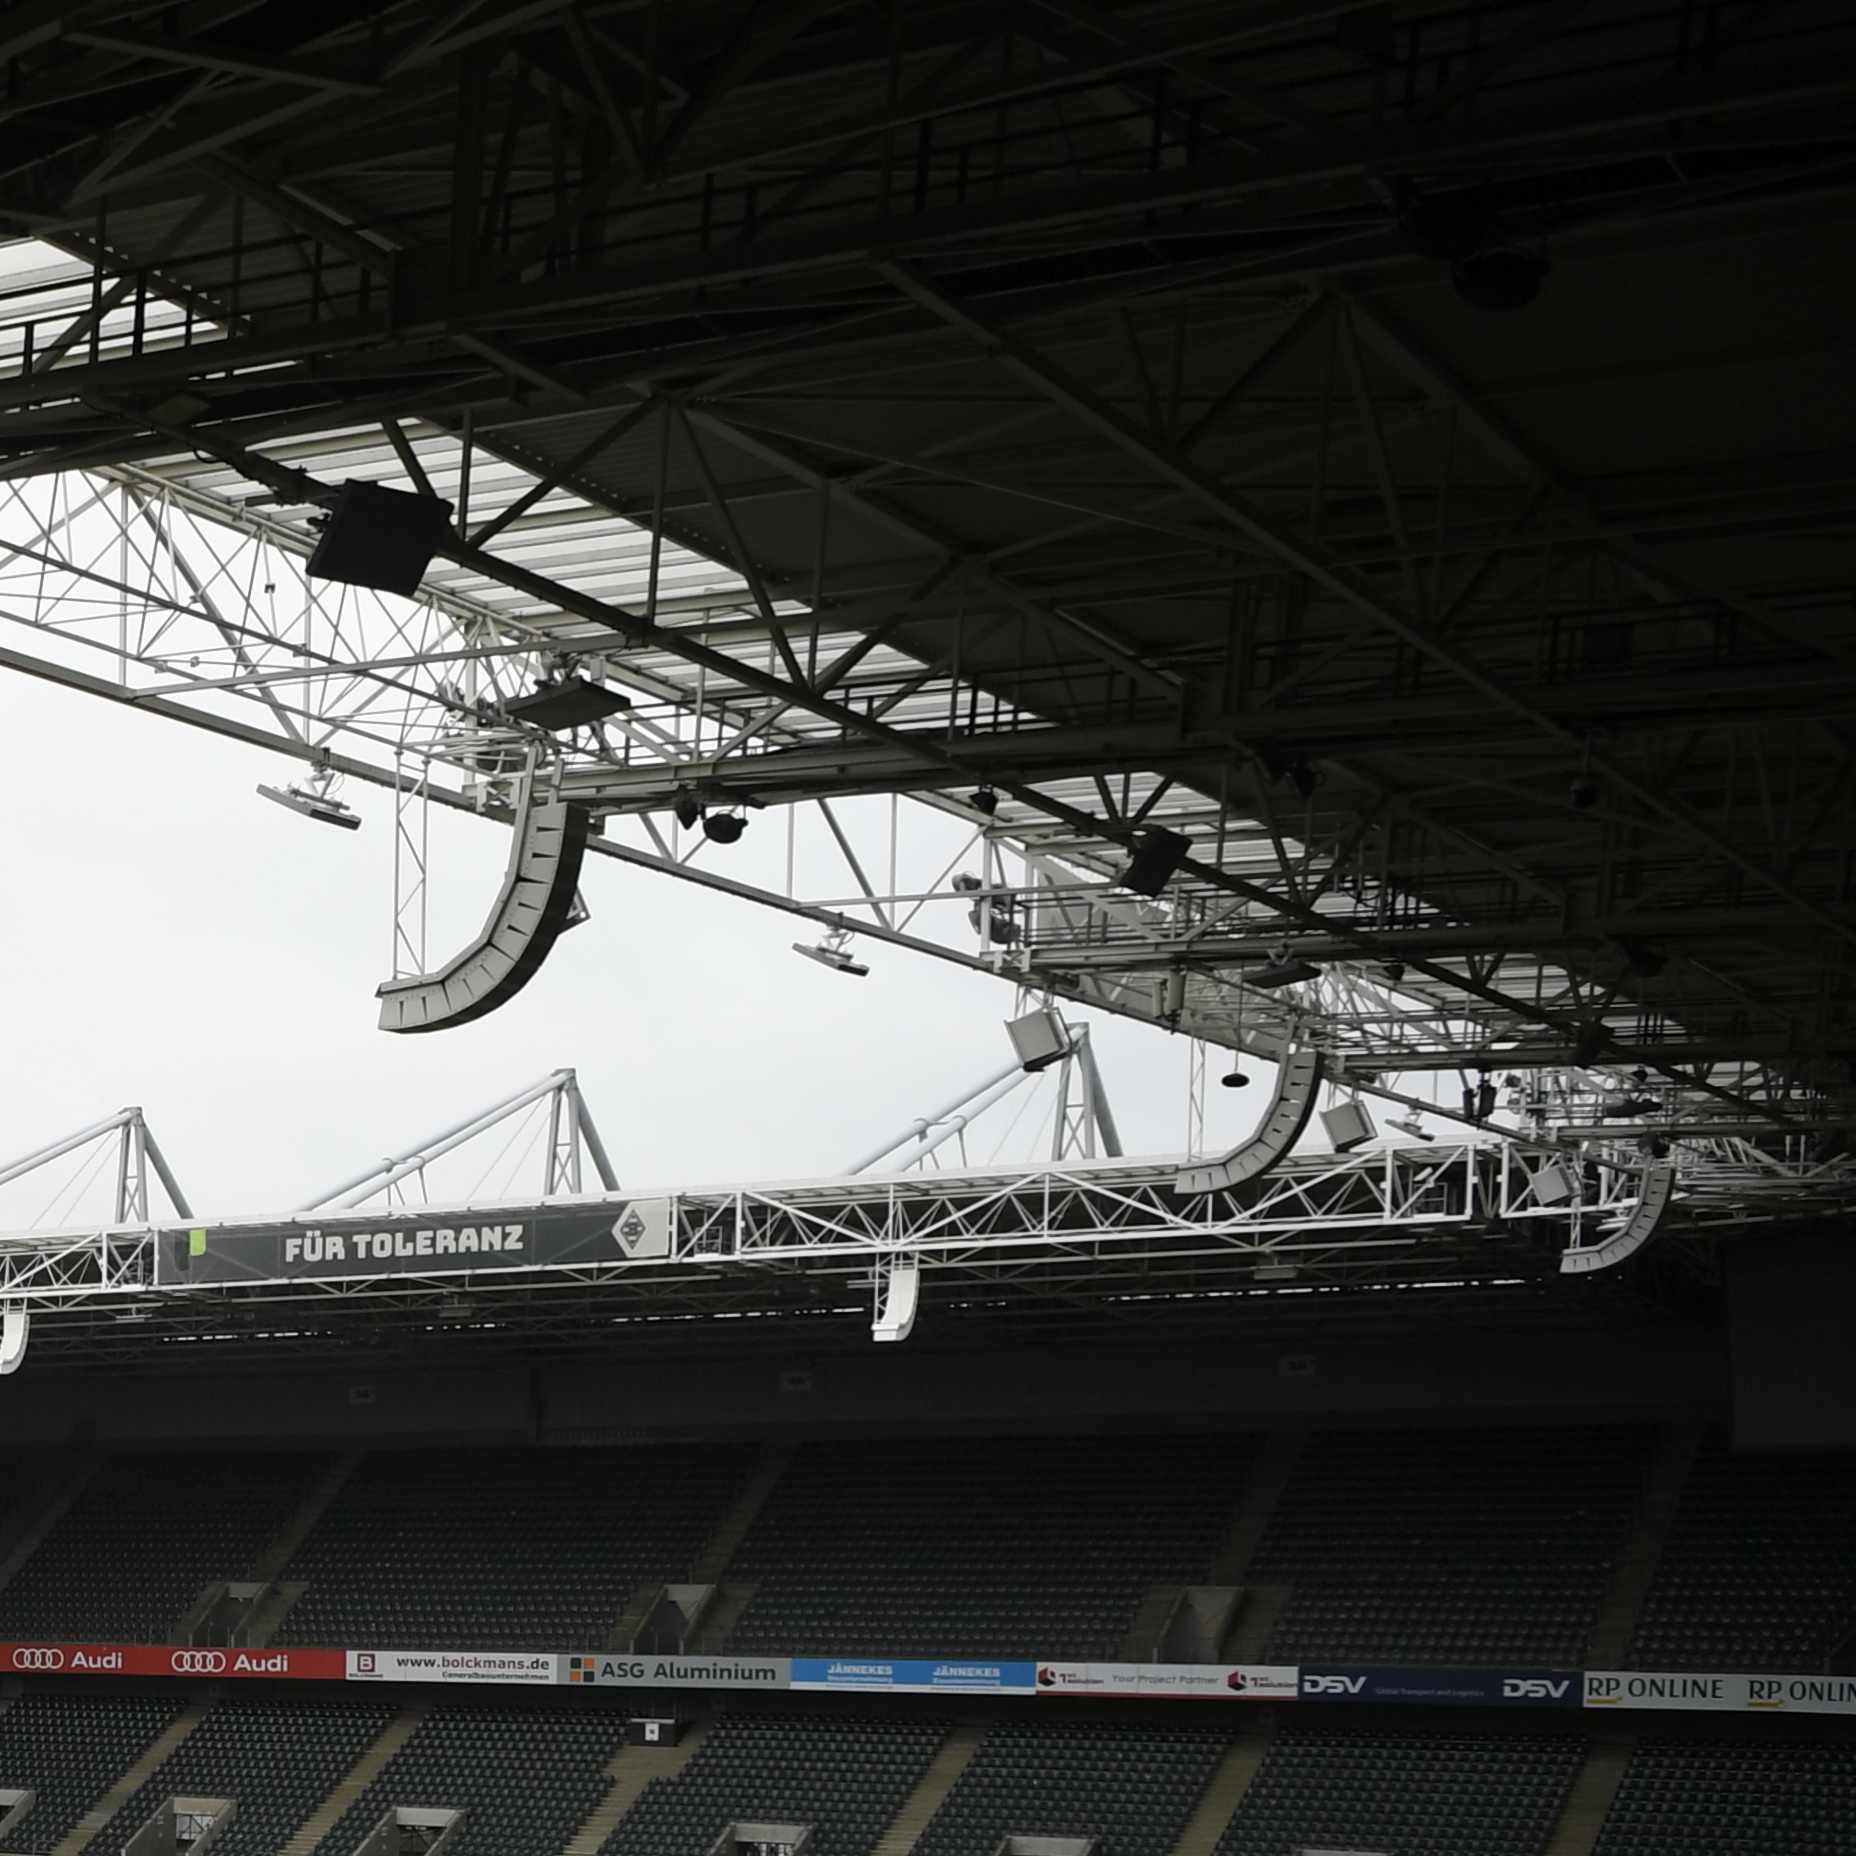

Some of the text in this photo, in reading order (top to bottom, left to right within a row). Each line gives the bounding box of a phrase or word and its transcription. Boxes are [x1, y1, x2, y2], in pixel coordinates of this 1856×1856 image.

[285, 1225, 524, 1263] FÜR TOLERANZ
[71, 1651, 124, 1671] Audi
[233, 1653, 289, 1673] Audi
[396, 1655, 551, 1673] www.bolckmans.de
[827, 1663, 893, 1677] JÄNNEKES
[600, 1660, 777, 1683] ASG Aluminium
[932, 1665, 1001, 1679] JÄNNEKES
[1112, 1674, 1134, 1685] Your
[1138, 1675, 1176, 1687] Project
[1303, 1675, 1368, 1694] DSV
[1502, 1679, 1571, 1699] DSV
[1588, 1678, 1725, 1699] RP ONLINE
[1748, 1681, 1856, 1703] RP ONLIN
